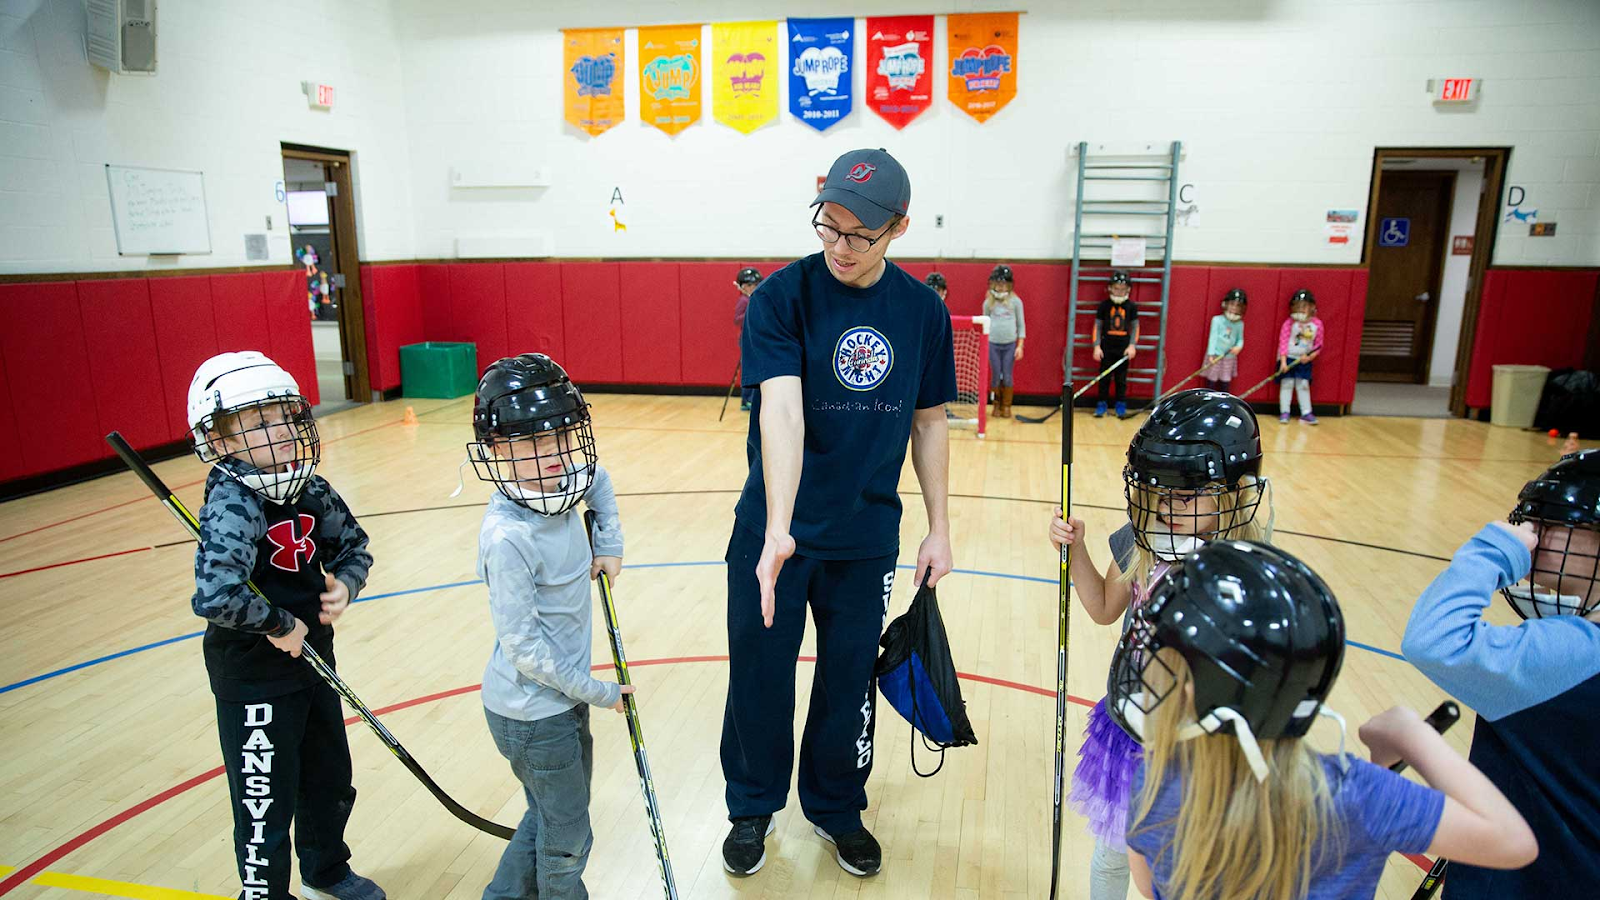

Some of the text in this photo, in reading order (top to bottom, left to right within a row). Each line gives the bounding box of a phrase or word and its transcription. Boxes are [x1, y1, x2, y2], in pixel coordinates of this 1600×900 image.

[794, 55, 848, 75] JUMP ROPE
[652, 68, 691, 90] JUMP
[1442, 78, 1473, 100] EXIT
[319, 84, 333, 106] EXIT
[802, 109, 840, 119] 2010-2011
[274, 181, 286, 203] 6
[610, 186, 624, 204] A
[1179, 183, 1194, 204] C
[1507, 186, 1526, 207] D
[840, 334, 887, 358] HOCKEY
[841, 364, 882, 384] NIGHT
[241, 702, 275, 900] DANSVILLE
